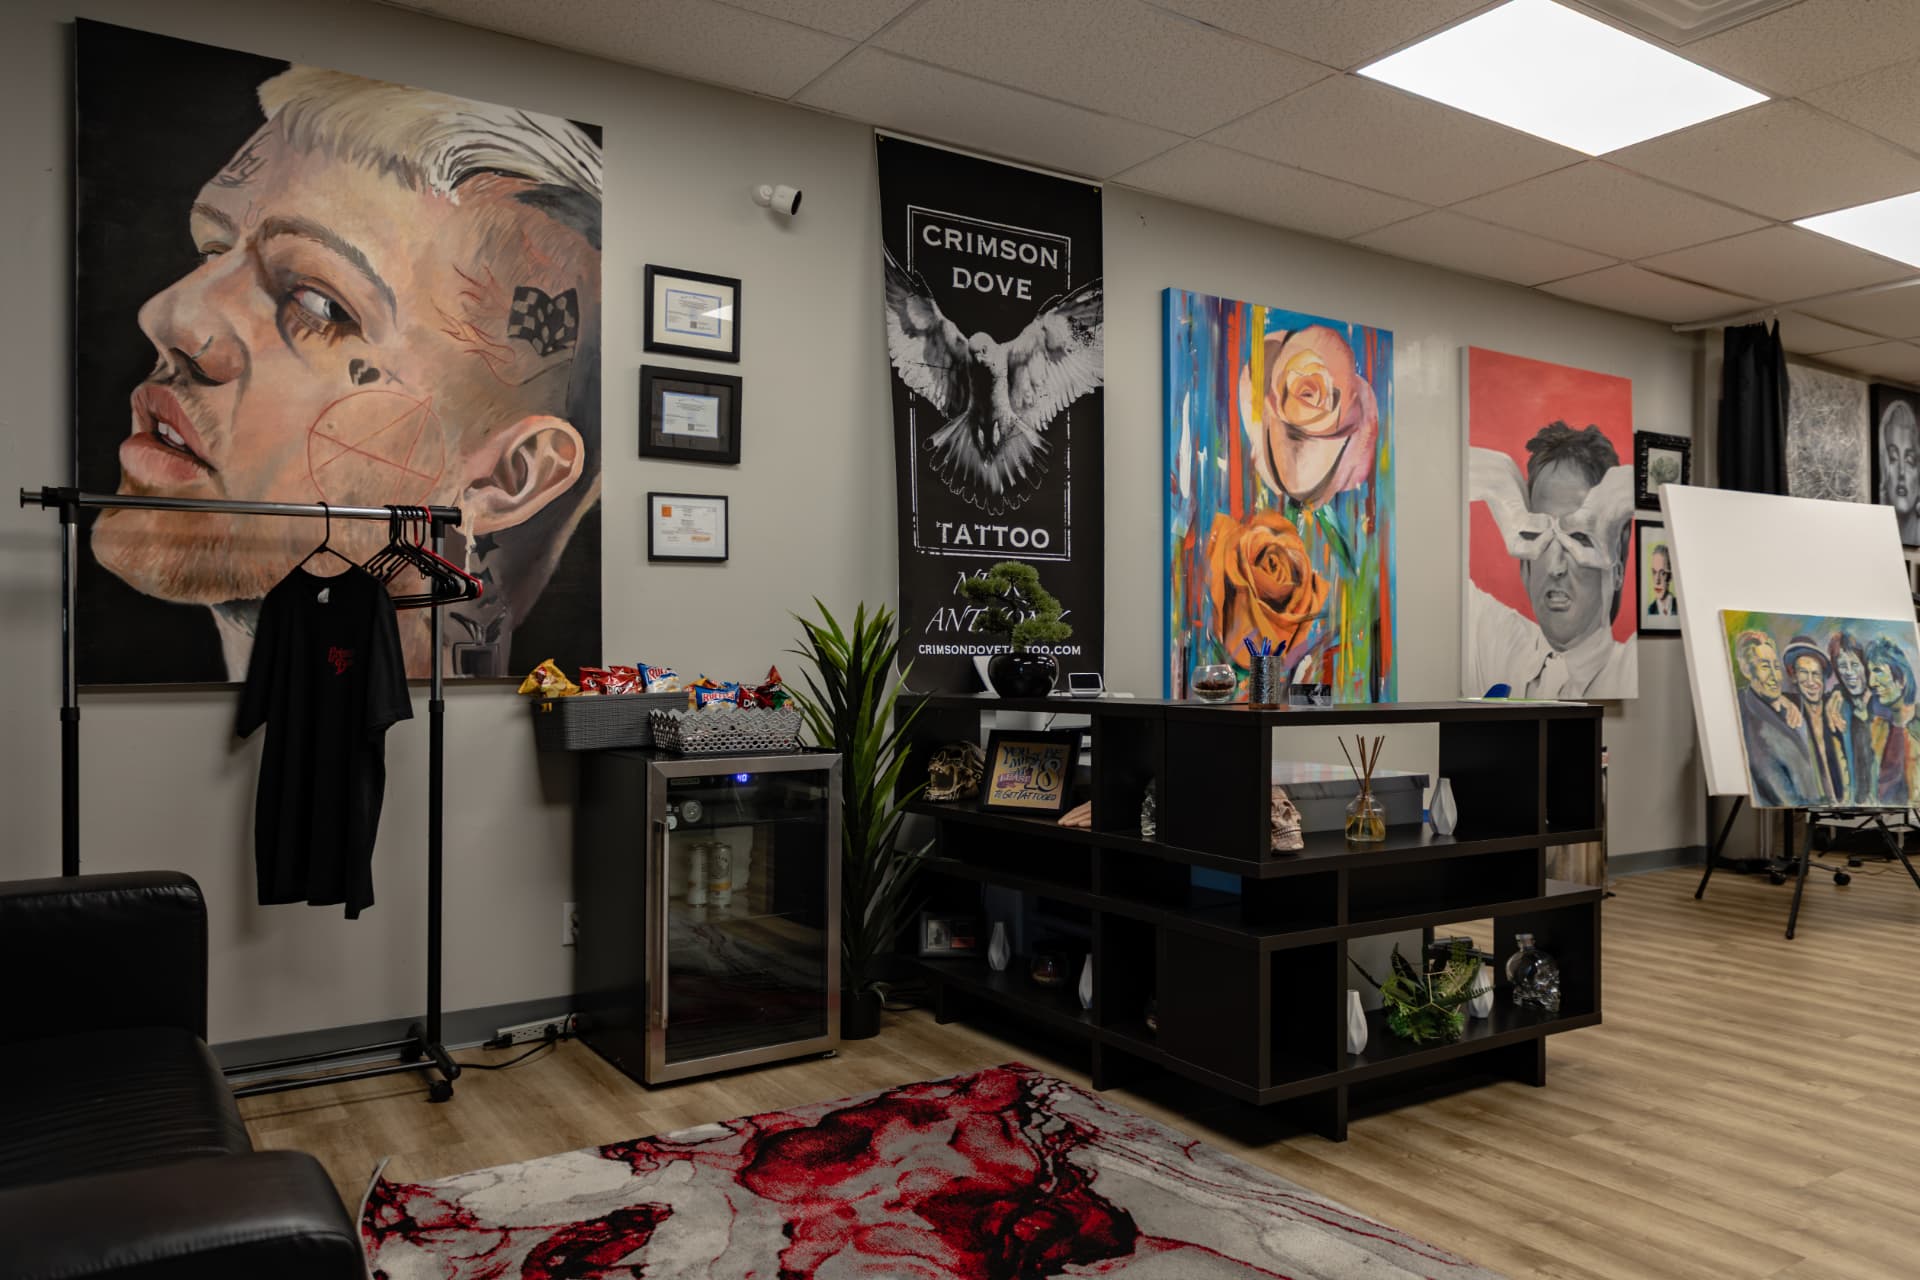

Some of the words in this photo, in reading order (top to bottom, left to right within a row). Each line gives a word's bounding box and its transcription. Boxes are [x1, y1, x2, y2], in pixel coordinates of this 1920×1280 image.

[922, 224, 1059, 270] CRIMSON
[952, 267, 1032, 300] DOVE
[936, 521, 1050, 549] TATTOO
[1024, 759, 1061, 792] 18
